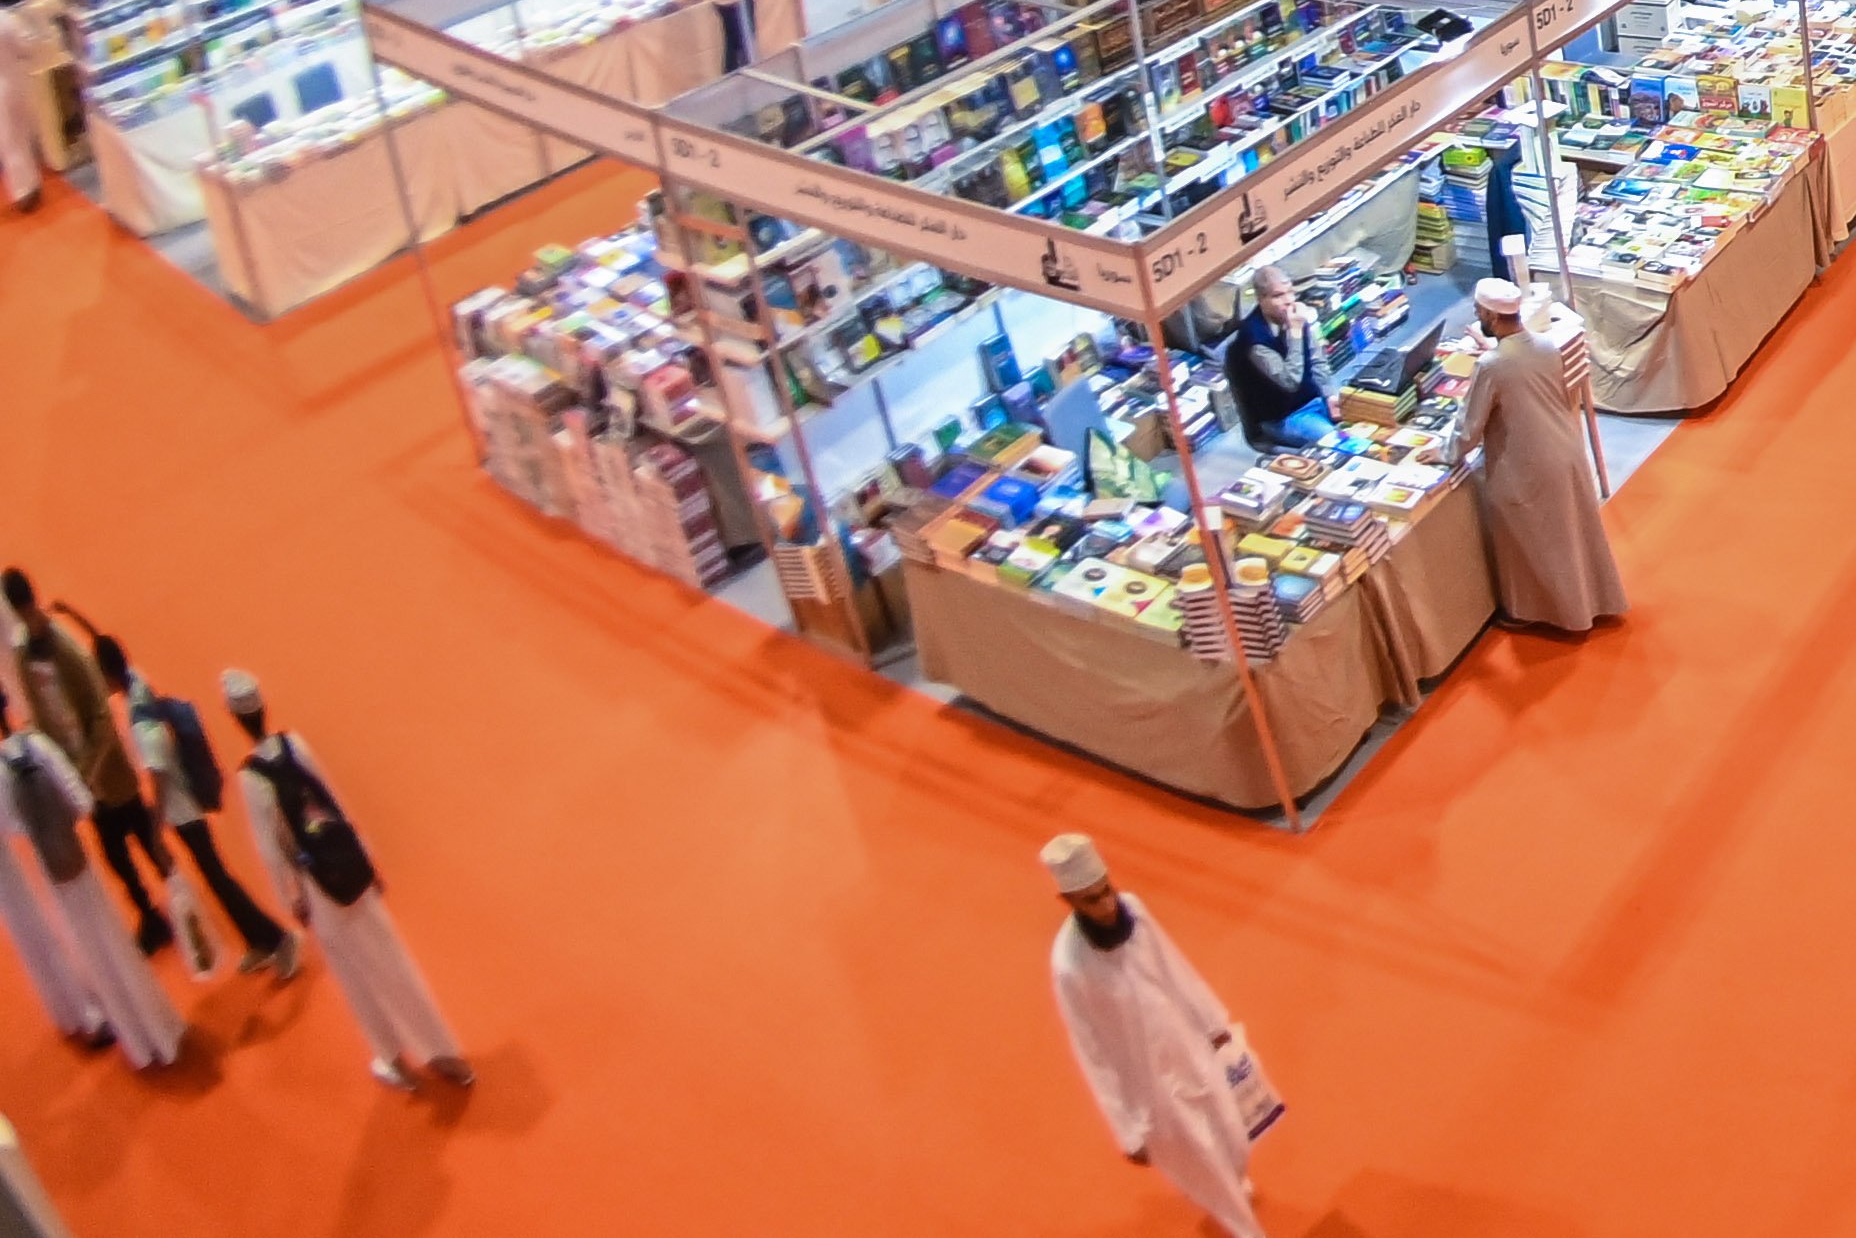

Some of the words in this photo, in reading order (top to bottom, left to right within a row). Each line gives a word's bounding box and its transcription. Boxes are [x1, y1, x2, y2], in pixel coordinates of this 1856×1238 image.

[1408, 100, 1421, 119] دار
[1152, 250, 1181, 283] 5D1
[1196, 232, 1208, 254] 2
